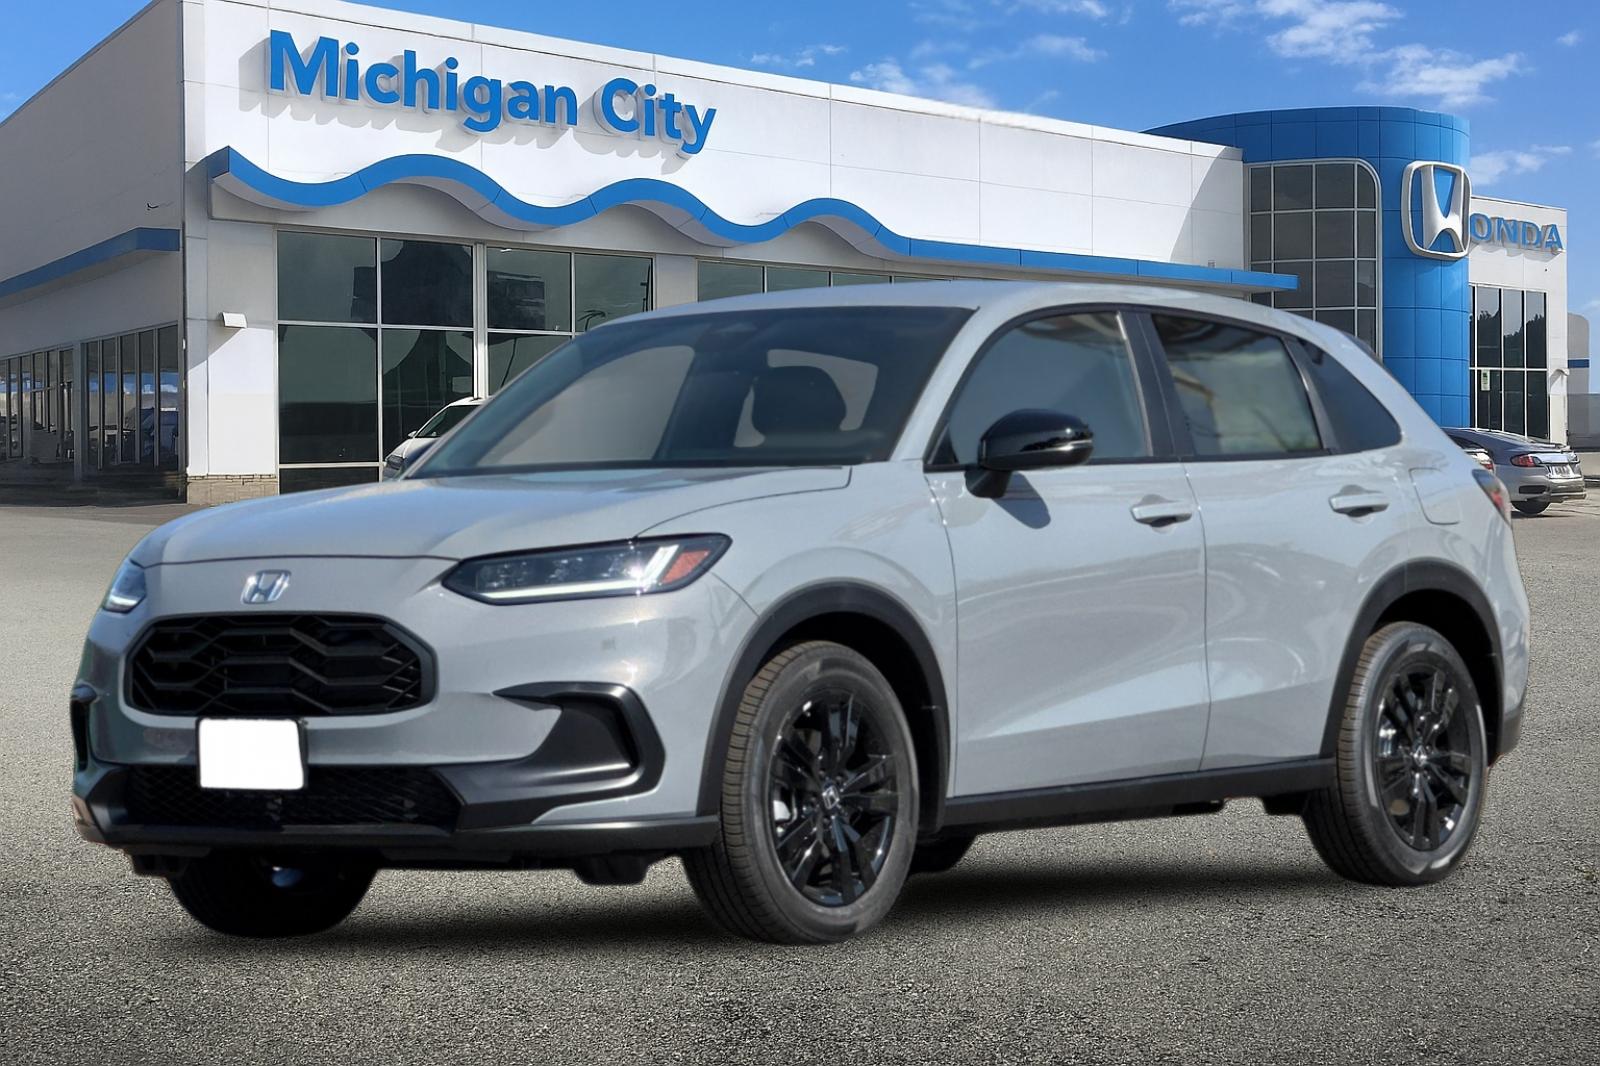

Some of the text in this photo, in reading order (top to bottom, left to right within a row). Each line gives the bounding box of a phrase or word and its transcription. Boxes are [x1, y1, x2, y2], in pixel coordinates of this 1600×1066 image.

[269, 29, 717, 155] Michigan City
[1469, 212, 1565, 250] ONDA
